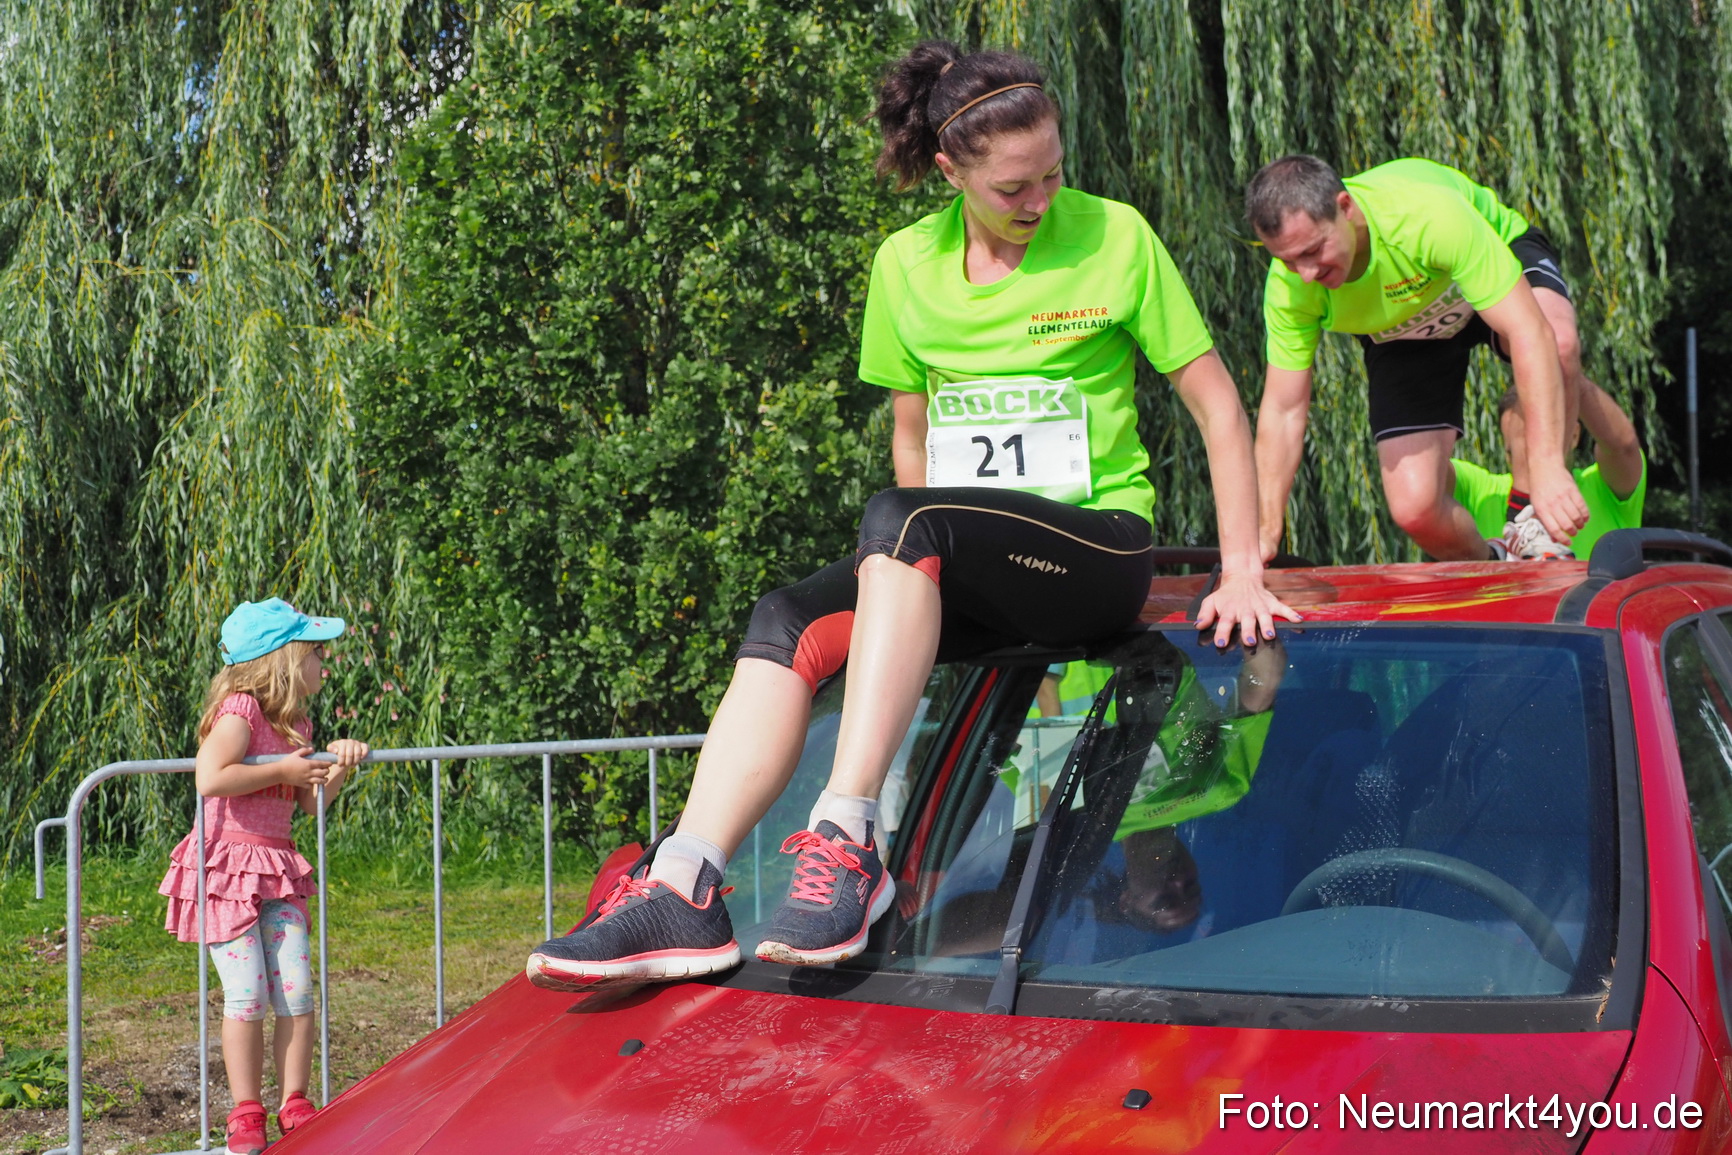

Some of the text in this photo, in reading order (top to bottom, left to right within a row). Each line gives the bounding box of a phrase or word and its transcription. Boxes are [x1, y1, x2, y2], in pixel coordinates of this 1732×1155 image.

[1031, 307, 1109, 322] NEUMARKTER
[1027, 318, 1113, 335] ELEMENTELAUF
[1416, 312, 1463, 337] 20
[1045, 334, 1089, 345] September
[936, 385, 1067, 420] BOCK
[1068, 433, 1081, 441] E6
[971, 433, 1026, 478] 21
